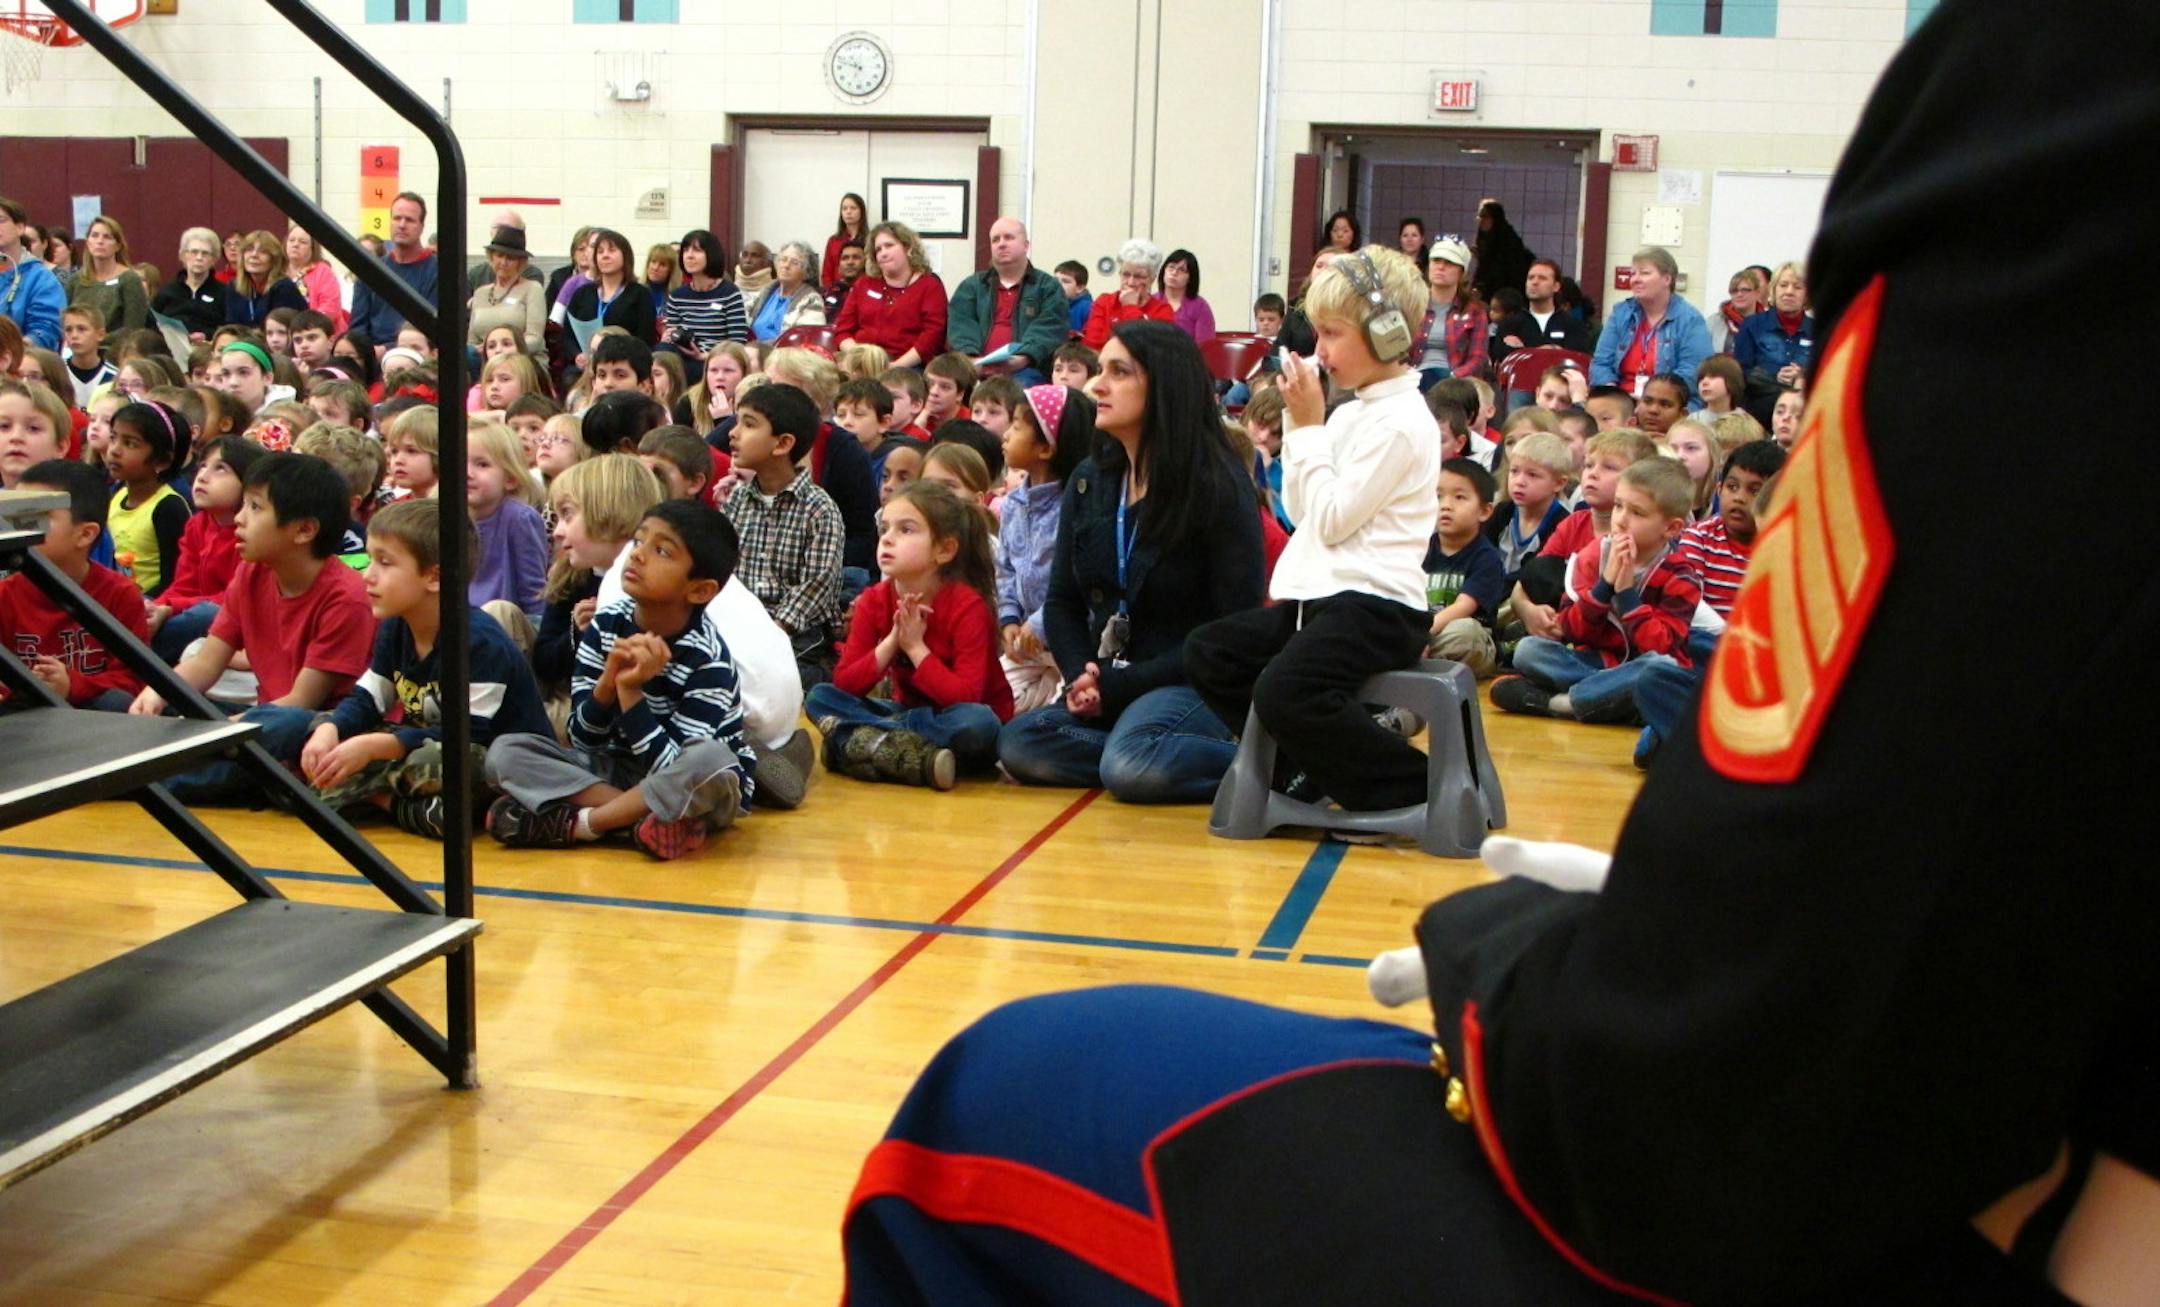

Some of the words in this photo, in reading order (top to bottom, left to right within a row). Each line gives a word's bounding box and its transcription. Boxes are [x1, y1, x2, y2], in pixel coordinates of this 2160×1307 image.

[1441, 81, 1473, 107] EXIT
[374, 155, 384, 168] 5
[375, 188, 384, 201] 4
[373, 217, 382, 230] 3
